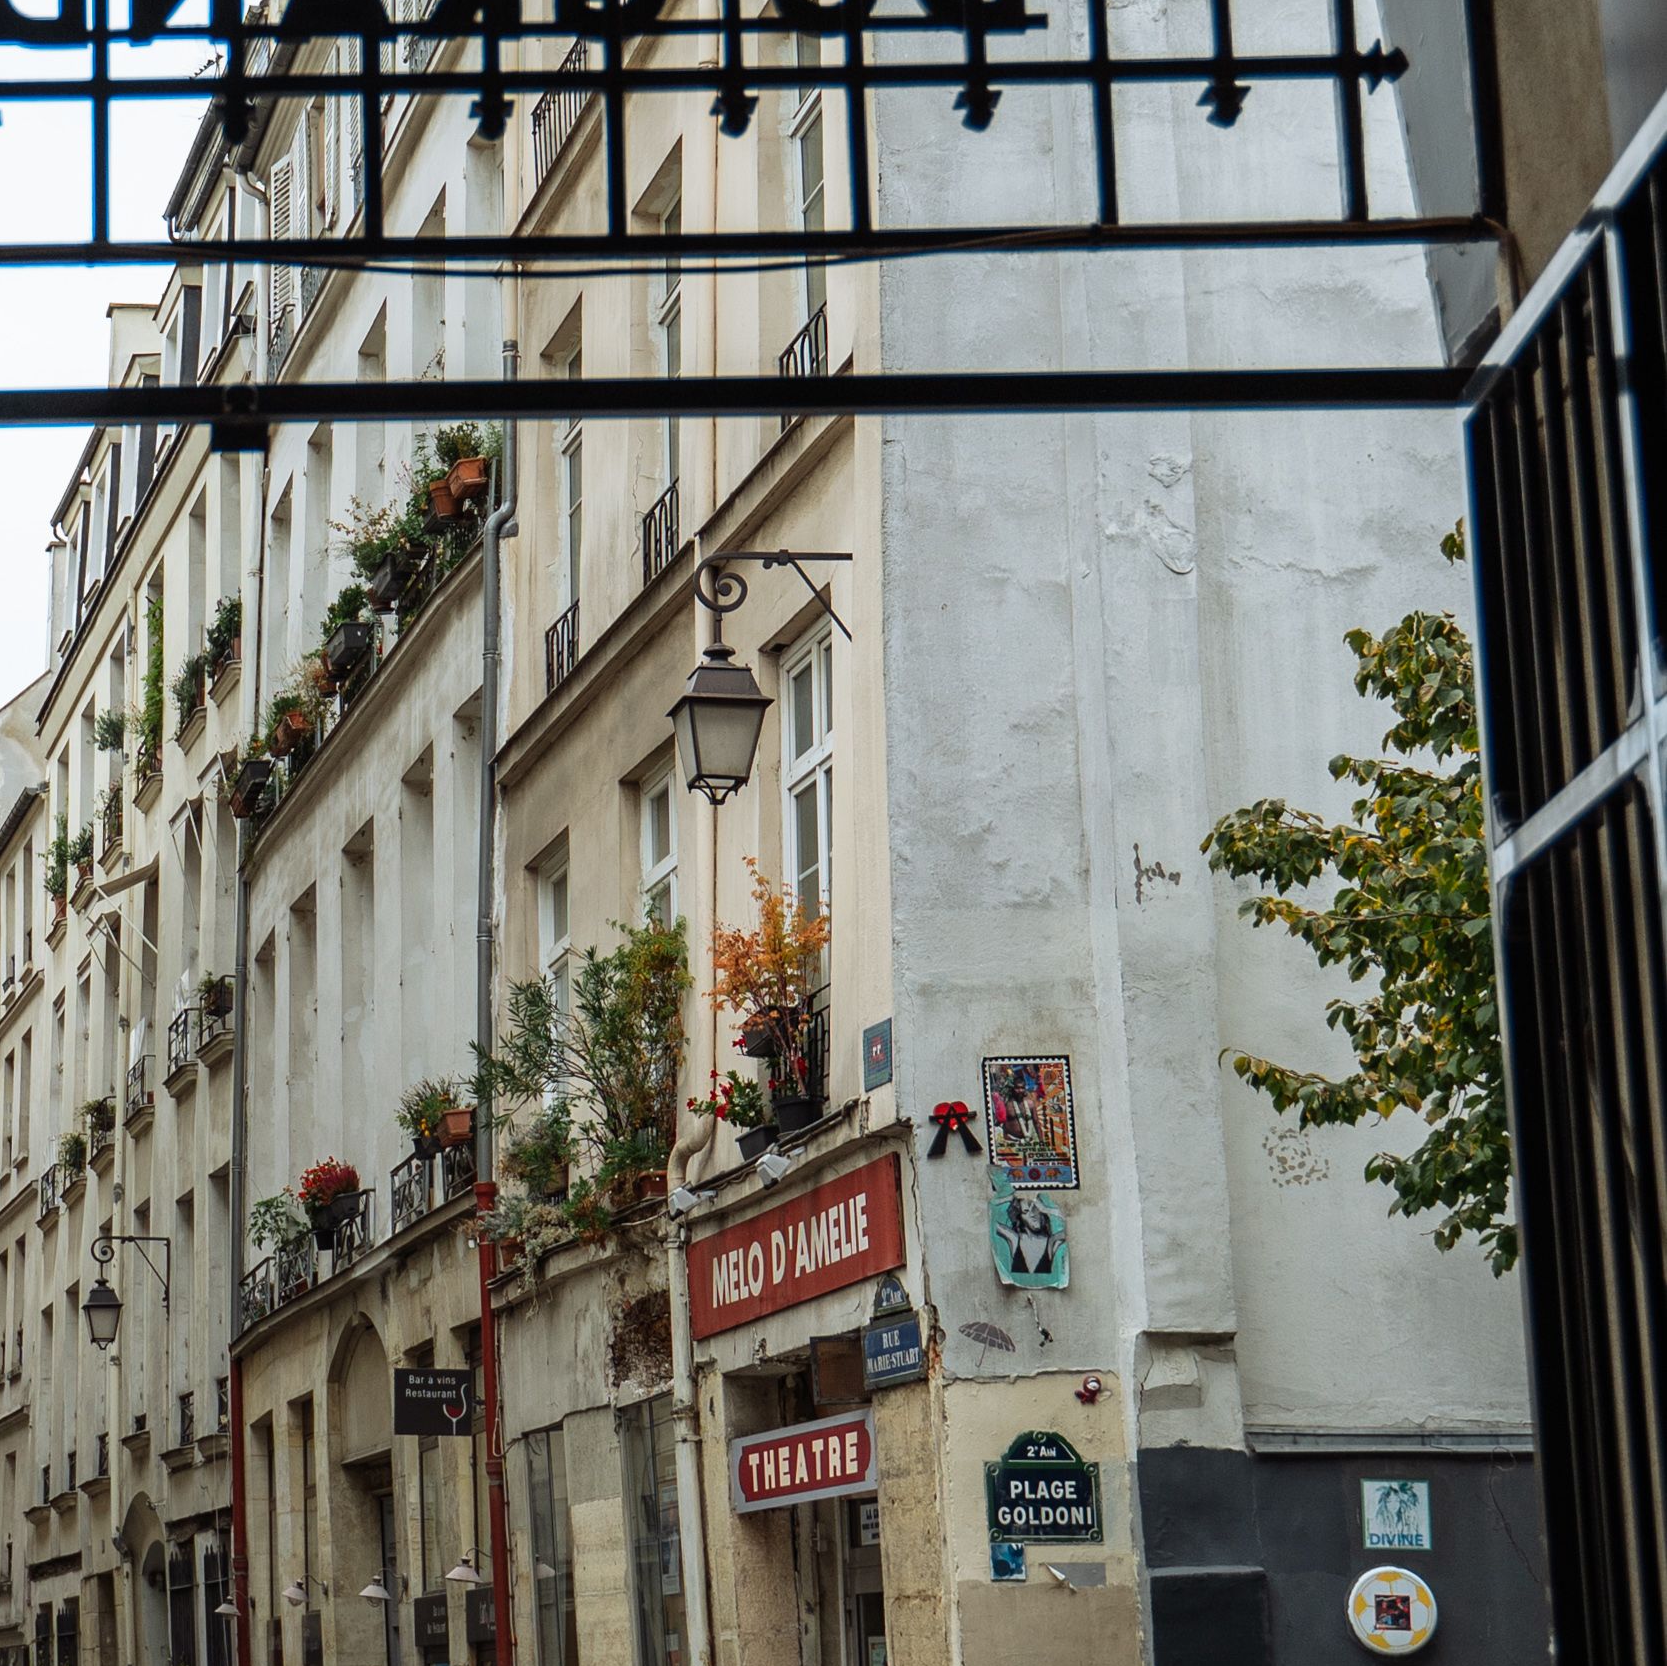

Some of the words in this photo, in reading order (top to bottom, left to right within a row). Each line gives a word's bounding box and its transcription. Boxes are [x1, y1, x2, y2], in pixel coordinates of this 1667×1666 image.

[713, 1241, 764, 1309] MELO
[771, 1192, 869, 1285] D'AMELIE
[882, 1330, 901, 1349] RUE
[867, 1347, 919, 1373] MARIE-STUART
[409, 1374, 424, 1384] Bar
[437, 1376, 456, 1384] vins
[406, 1388, 456, 1398] Restaurant
[748, 1431, 858, 1493] THEATRE
[1010, 1480, 1077, 1499] PLAGE
[997, 1506, 1093, 1525] GOLDONI
[1369, 1533, 1424, 1547] DIVINE
